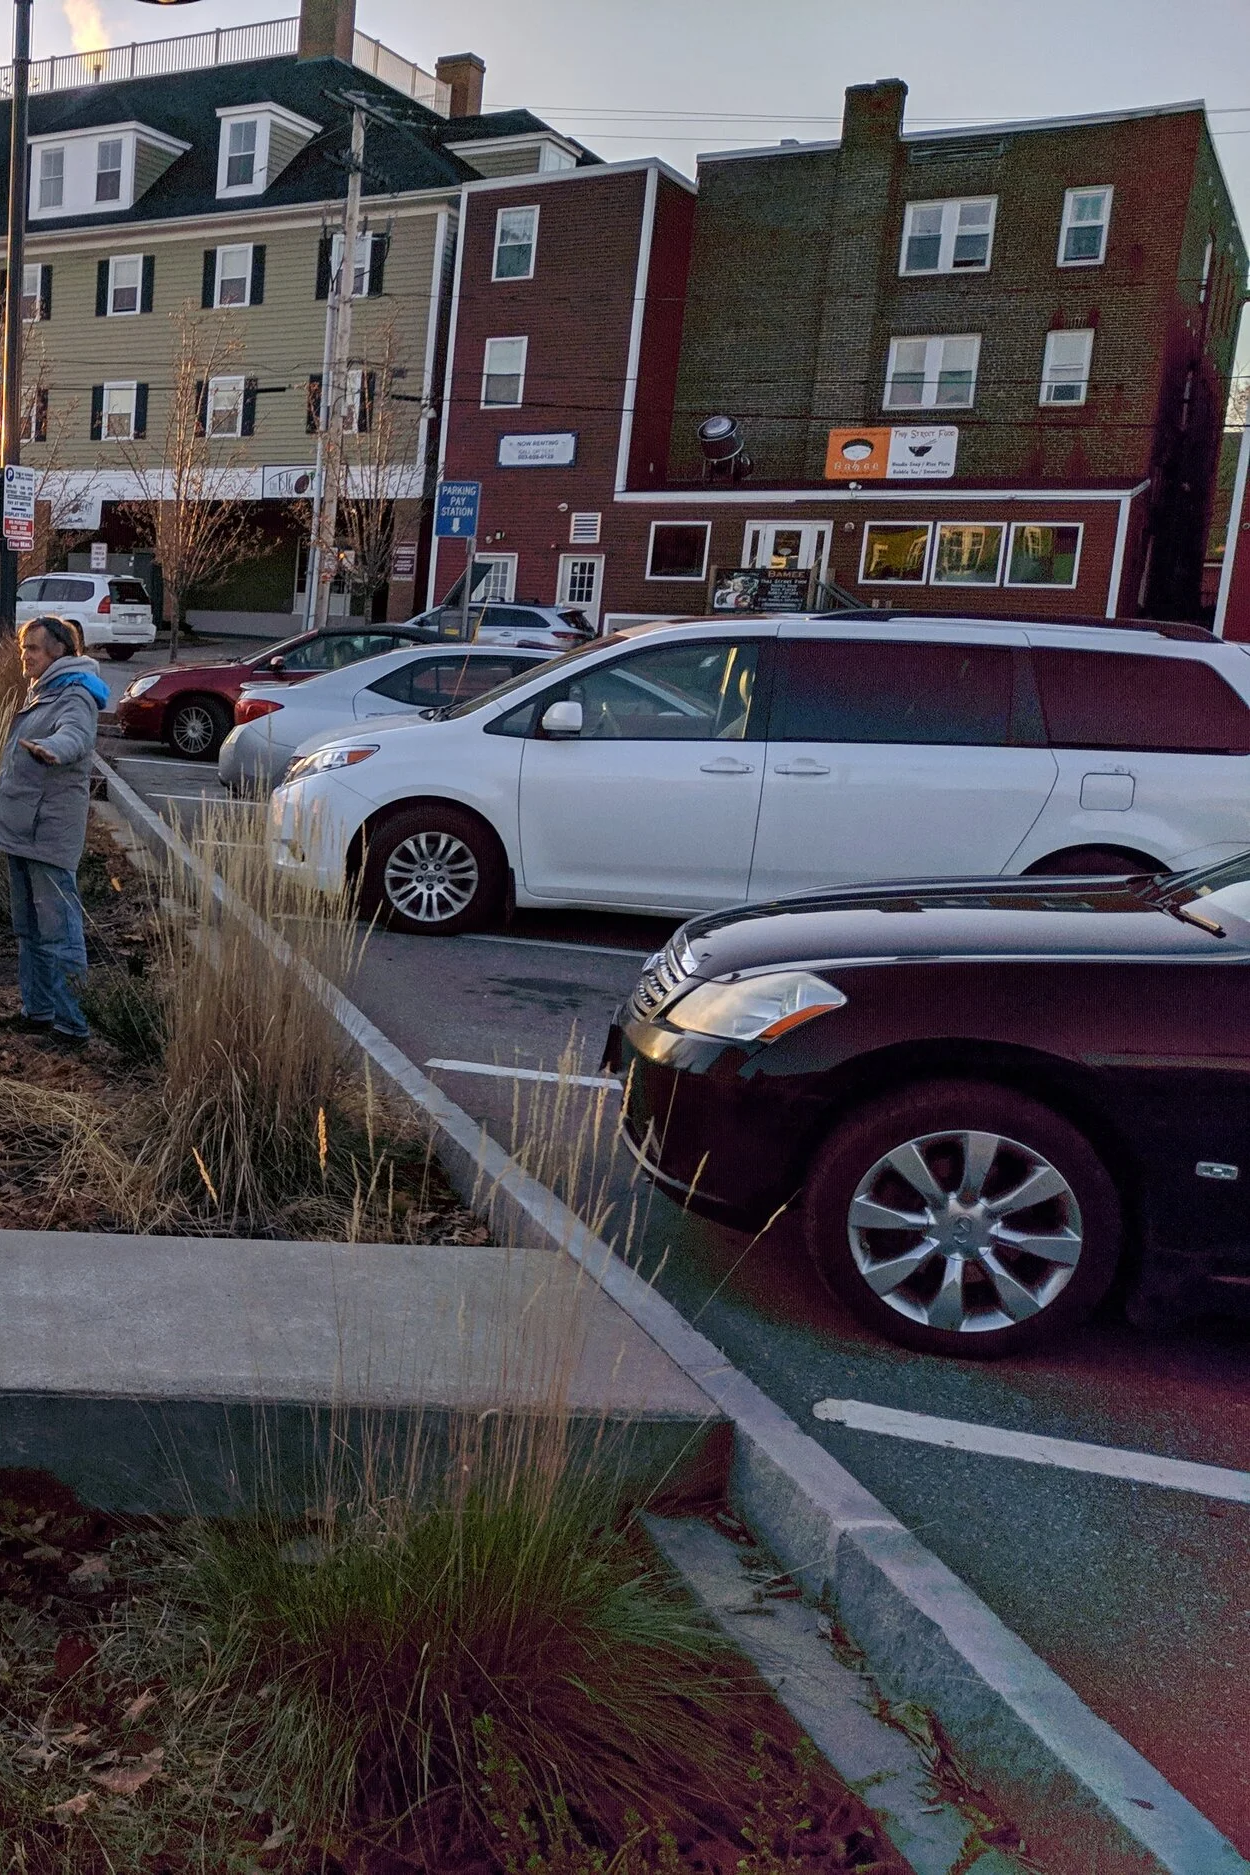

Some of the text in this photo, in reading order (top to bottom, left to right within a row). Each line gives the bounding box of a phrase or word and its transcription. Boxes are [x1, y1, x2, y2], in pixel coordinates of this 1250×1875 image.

[442, 486, 477, 496] PARKING
[450, 496, 467, 506] PAY
[440, 506, 474, 517] STATION
[768, 570, 806, 578] BAMEE
